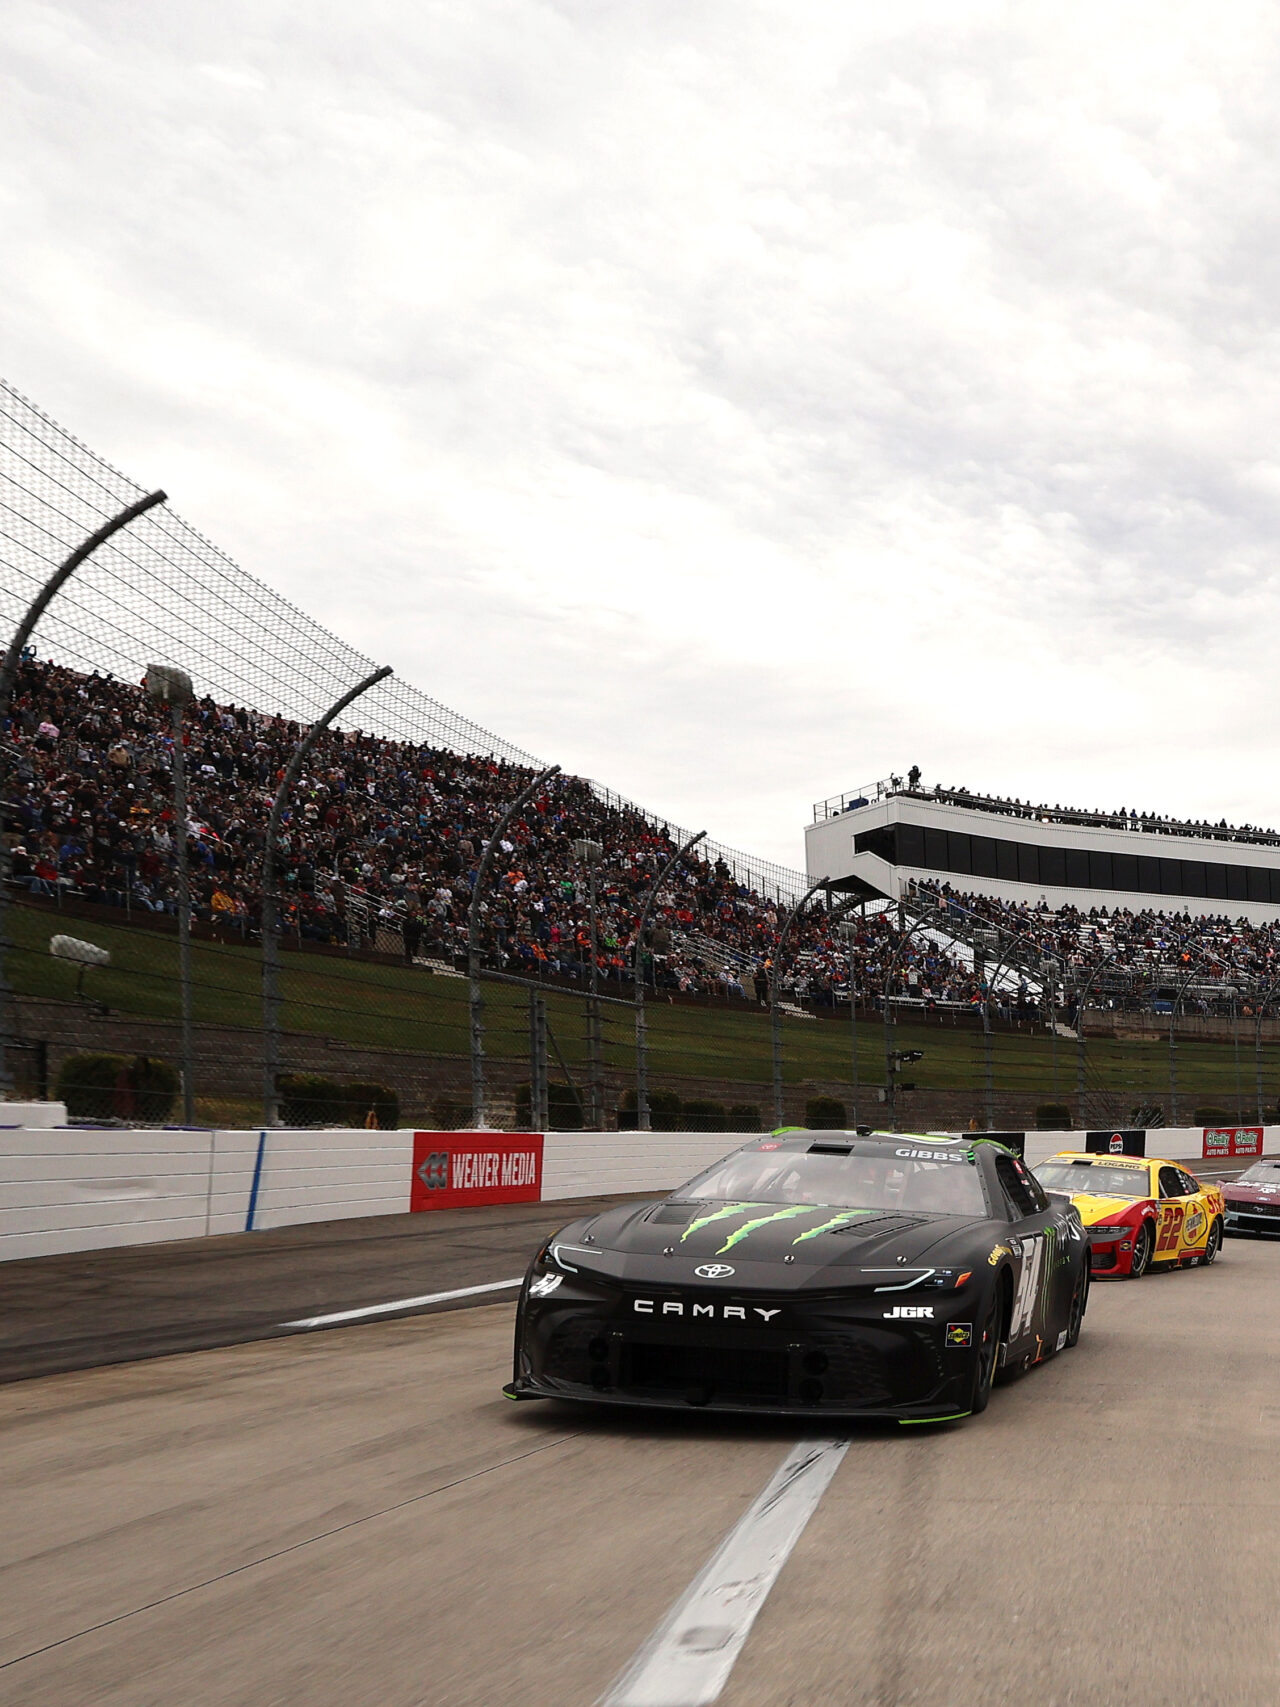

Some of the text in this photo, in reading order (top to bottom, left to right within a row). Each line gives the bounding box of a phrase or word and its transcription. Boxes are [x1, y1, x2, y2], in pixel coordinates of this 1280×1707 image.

[895, 1148, 962, 1162] GIBBS
[452, 1152, 536, 1189] WEAVER MEDIA
[1097, 1161, 1140, 1169] LOGANO
[1156, 1207, 1184, 1251] 22
[634, 1299, 782, 1322] CAMRY
[883, 1306, 934, 1318] JGR
